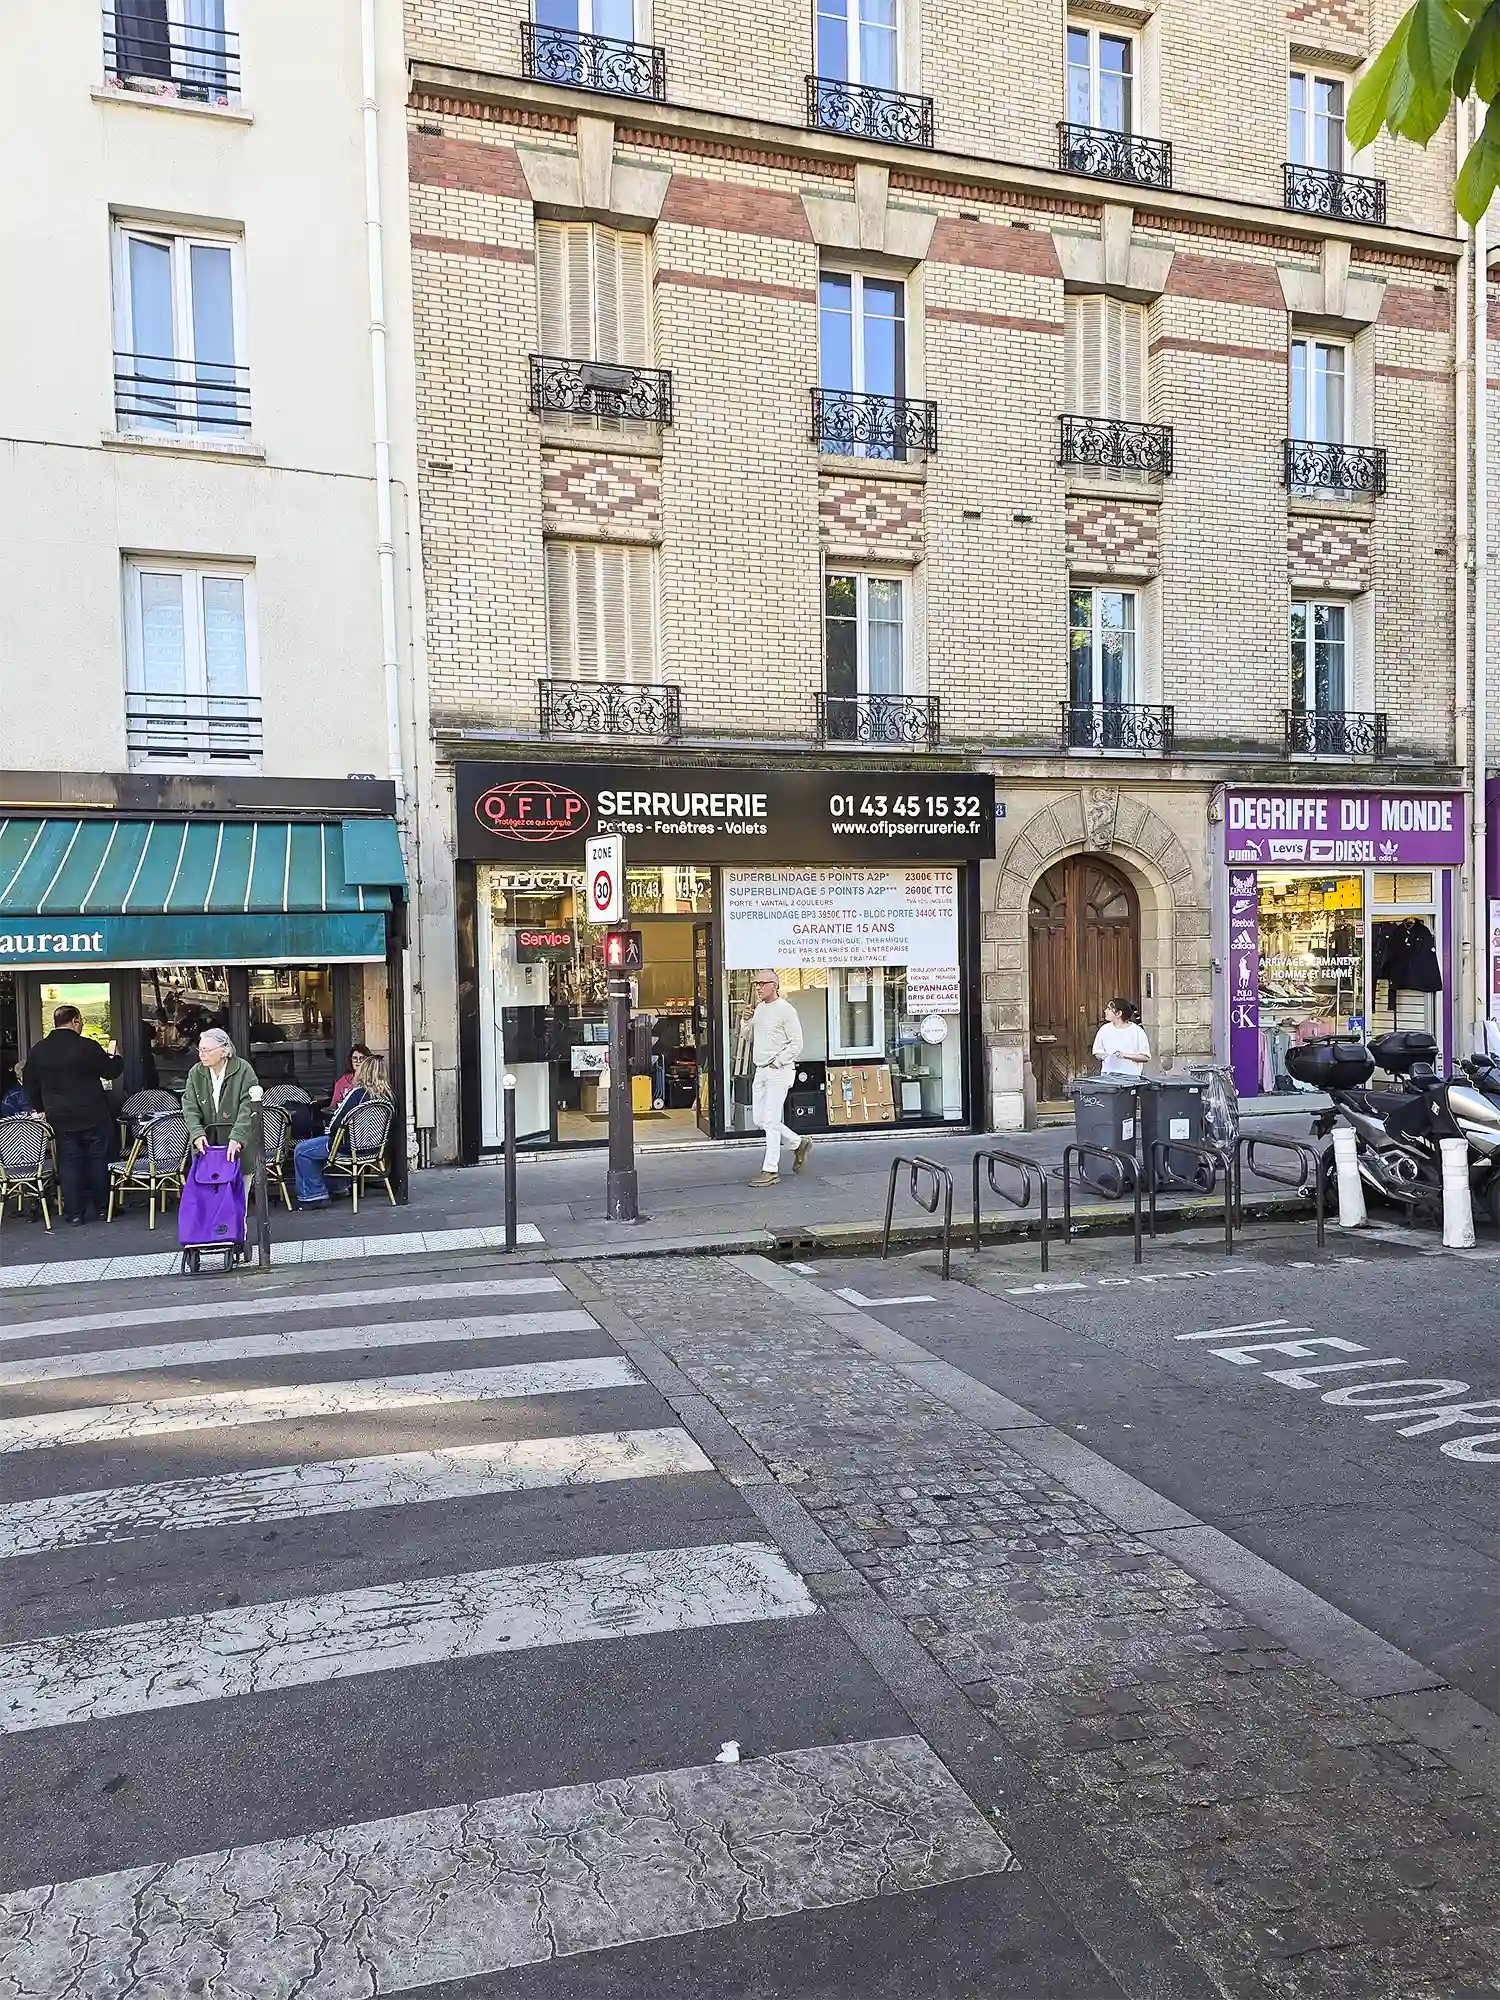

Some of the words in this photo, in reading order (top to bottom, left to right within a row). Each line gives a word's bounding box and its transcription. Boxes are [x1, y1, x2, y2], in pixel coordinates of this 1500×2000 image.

[484, 796, 582, 819] OFIP
[596, 790, 768, 817] SERRURERIE
[829, 795, 854, 817] 01
[860, 795, 888, 817] 43
[893, 796, 921, 817] 45
[925, 796, 949, 817] 15
[953, 796, 981, 818] 32
[1229, 797, 1328, 831] DEGRIFFE
[1340, 799, 1370, 831] DU
[1381, 799, 1453, 832] MONDE
[655, 820, 715, 835] Fenêtres
[724, 821, 768, 835] Volets
[831, 820, 981, 837] www.ofipserrurerie.fr
[592, 846, 612, 860] ZONE
[1335, 839, 1376, 862] DIESEL
[729, 872, 817, 882] SUPERBLINDAGE
[820, 872, 826, 882] 5
[828, 872, 865, 881] POINTS
[905, 872, 932, 881] 2300€
[934, 872, 953, 881] TTC
[596, 882, 609, 899] 30
[729, 887, 817, 896] SUPERBLINDAGE
[820, 887, 826, 896] 5
[828, 886, 865, 896] POINTS
[905, 886, 932, 895] 2600€
[934, 886, 953, 895] TTC
[730, 911, 800, 920] SUPERBLINDAGE
[842, 910, 858, 919] TTC
[863, 909, 886, 918] BLOC
[887, 909, 914, 918] PORTE
[938, 909, 953, 917] TTC
[792, 923, 853, 934] GARANTIE
[857, 923, 869, 933] 15
[871, 923, 895, 933] ANS
[1231, 918, 1255, 928] Reebok
[520, 932, 571, 946] Service
[1230, 942, 1256, 950] adidas
[1258, 957, 1305, 967] ARRIVAGE
[1271, 969, 1307, 979] HOMME
[1308, 969, 1320, 978] ET
[1321, 968, 1353, 978] FEMME
[907, 984, 959, 992] DEPANNAGE
